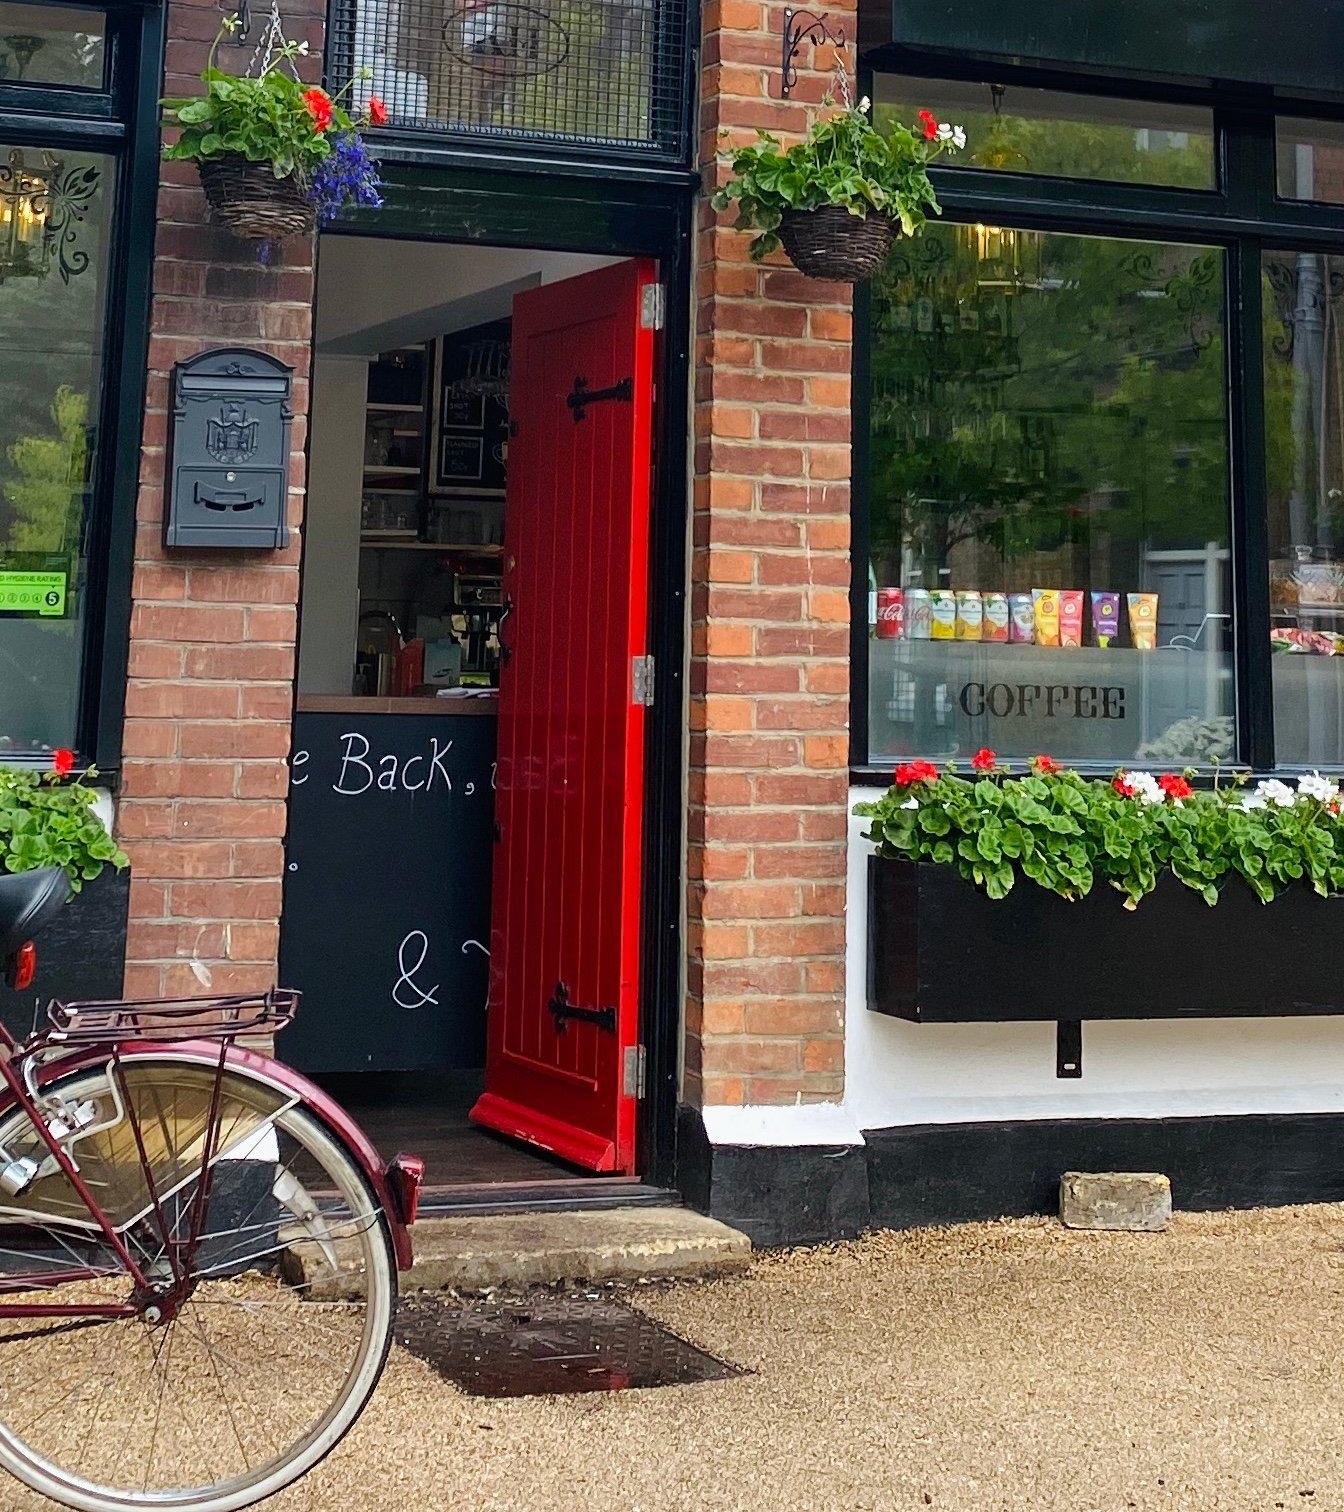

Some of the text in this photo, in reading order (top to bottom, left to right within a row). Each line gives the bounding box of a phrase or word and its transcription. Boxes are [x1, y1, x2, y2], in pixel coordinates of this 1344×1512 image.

[48, 592, 57, 605] 5
[959, 682, 1126, 720] COFFEE
[392, 930, 439, 1009] &
